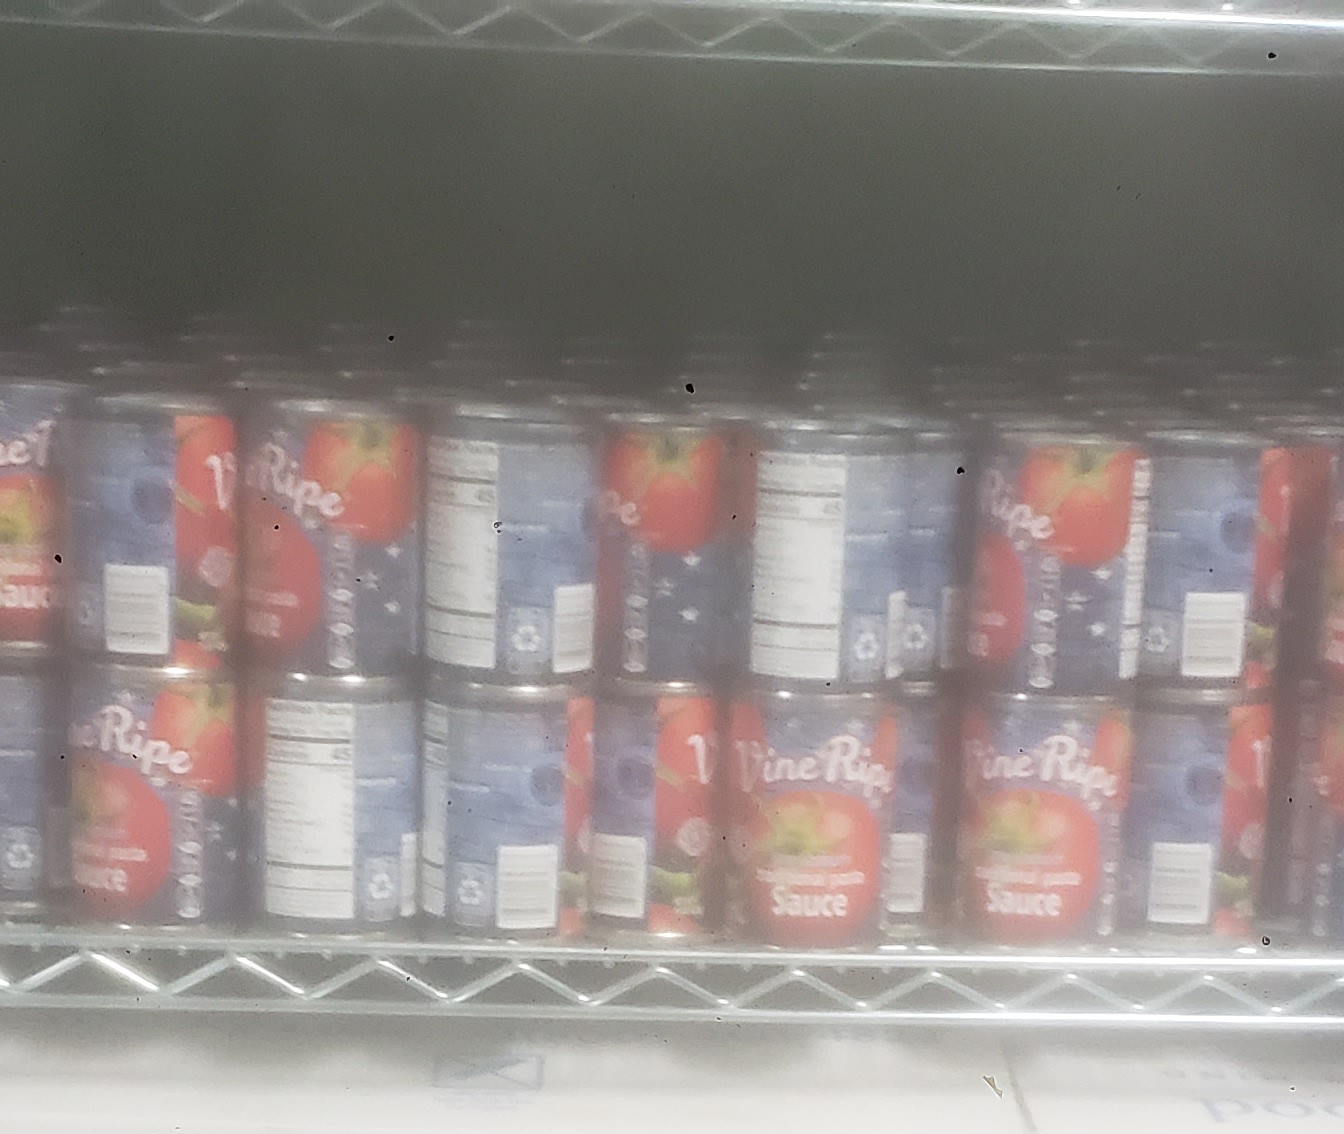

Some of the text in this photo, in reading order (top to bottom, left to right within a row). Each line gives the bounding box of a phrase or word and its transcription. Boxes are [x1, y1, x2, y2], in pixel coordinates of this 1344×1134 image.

[256, 440, 345, 517] Ripe
[97, 704, 193, 775] Ripe
[771, 884, 849, 918] Sauce
[986, 881, 1062, 917] Sauce
